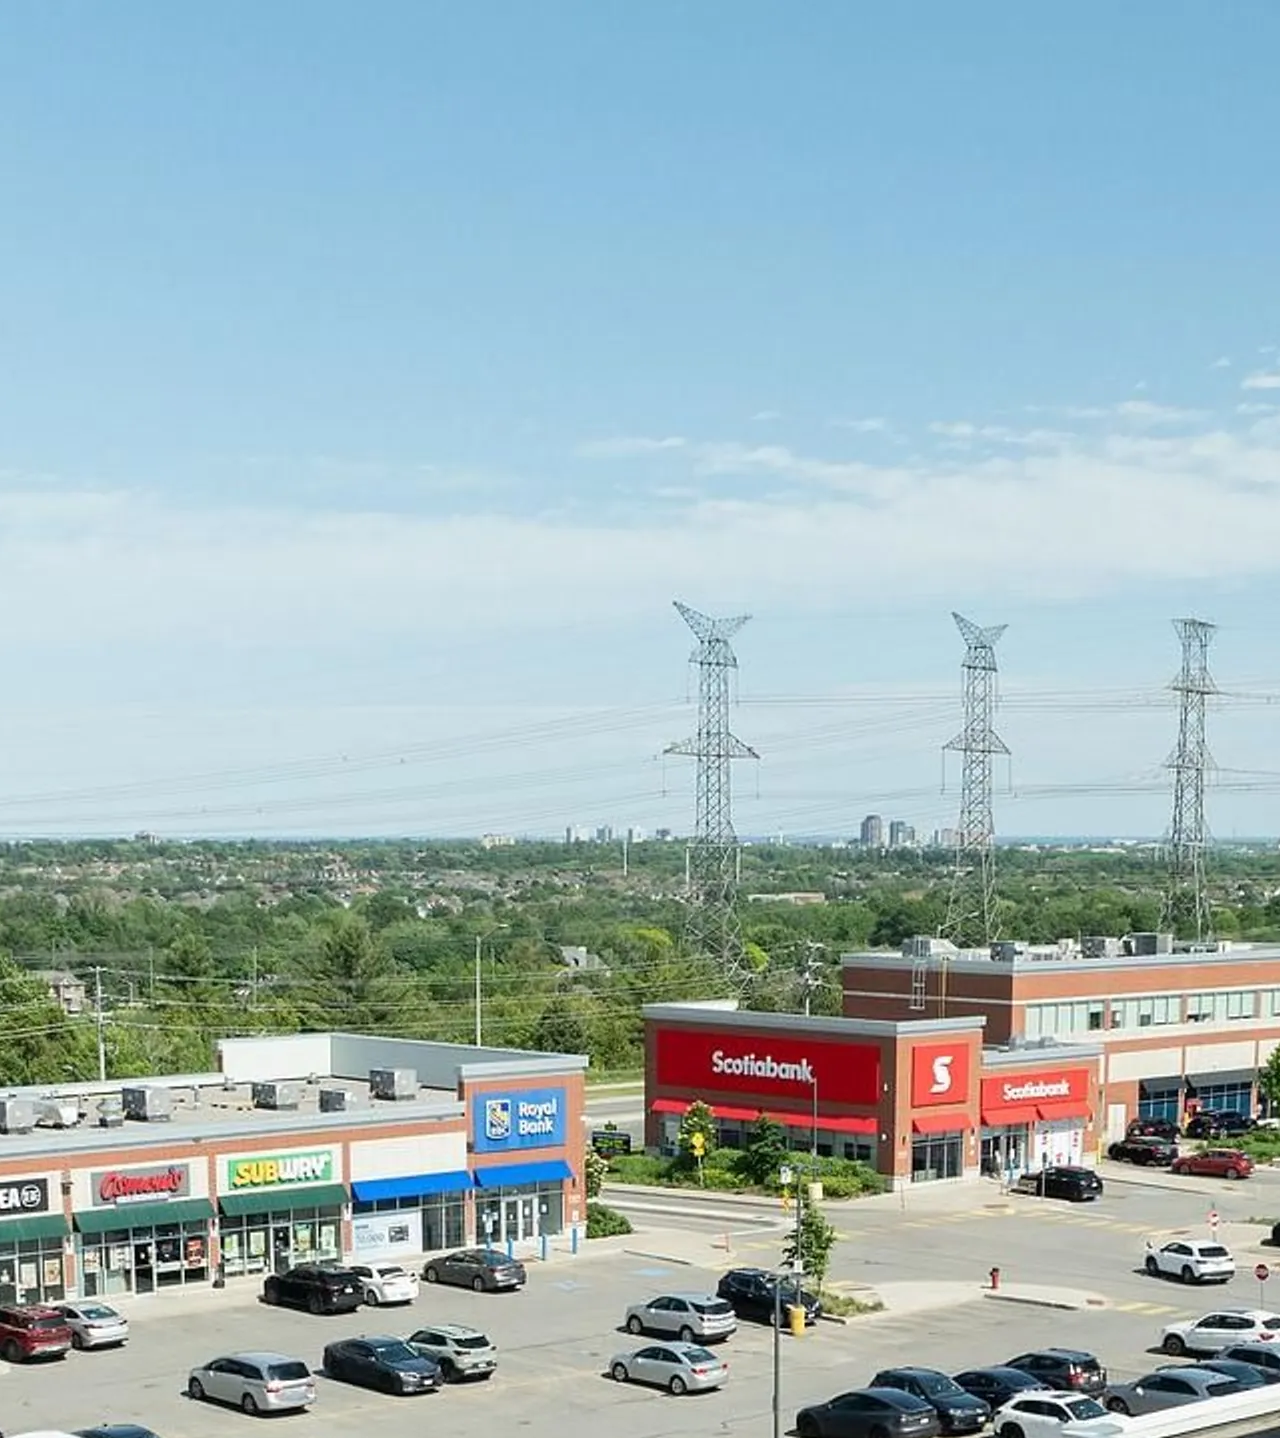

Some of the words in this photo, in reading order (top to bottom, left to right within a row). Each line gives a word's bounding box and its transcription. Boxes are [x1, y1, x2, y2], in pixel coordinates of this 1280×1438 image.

[711, 1050, 814, 1083] Scotiabank
[1003, 1078, 1070, 1101] Scotiabank
[518, 1097, 557, 1119] Royal
[518, 1117, 554, 1136] Bank
[234, 1153, 332, 1185] SUBWAY
